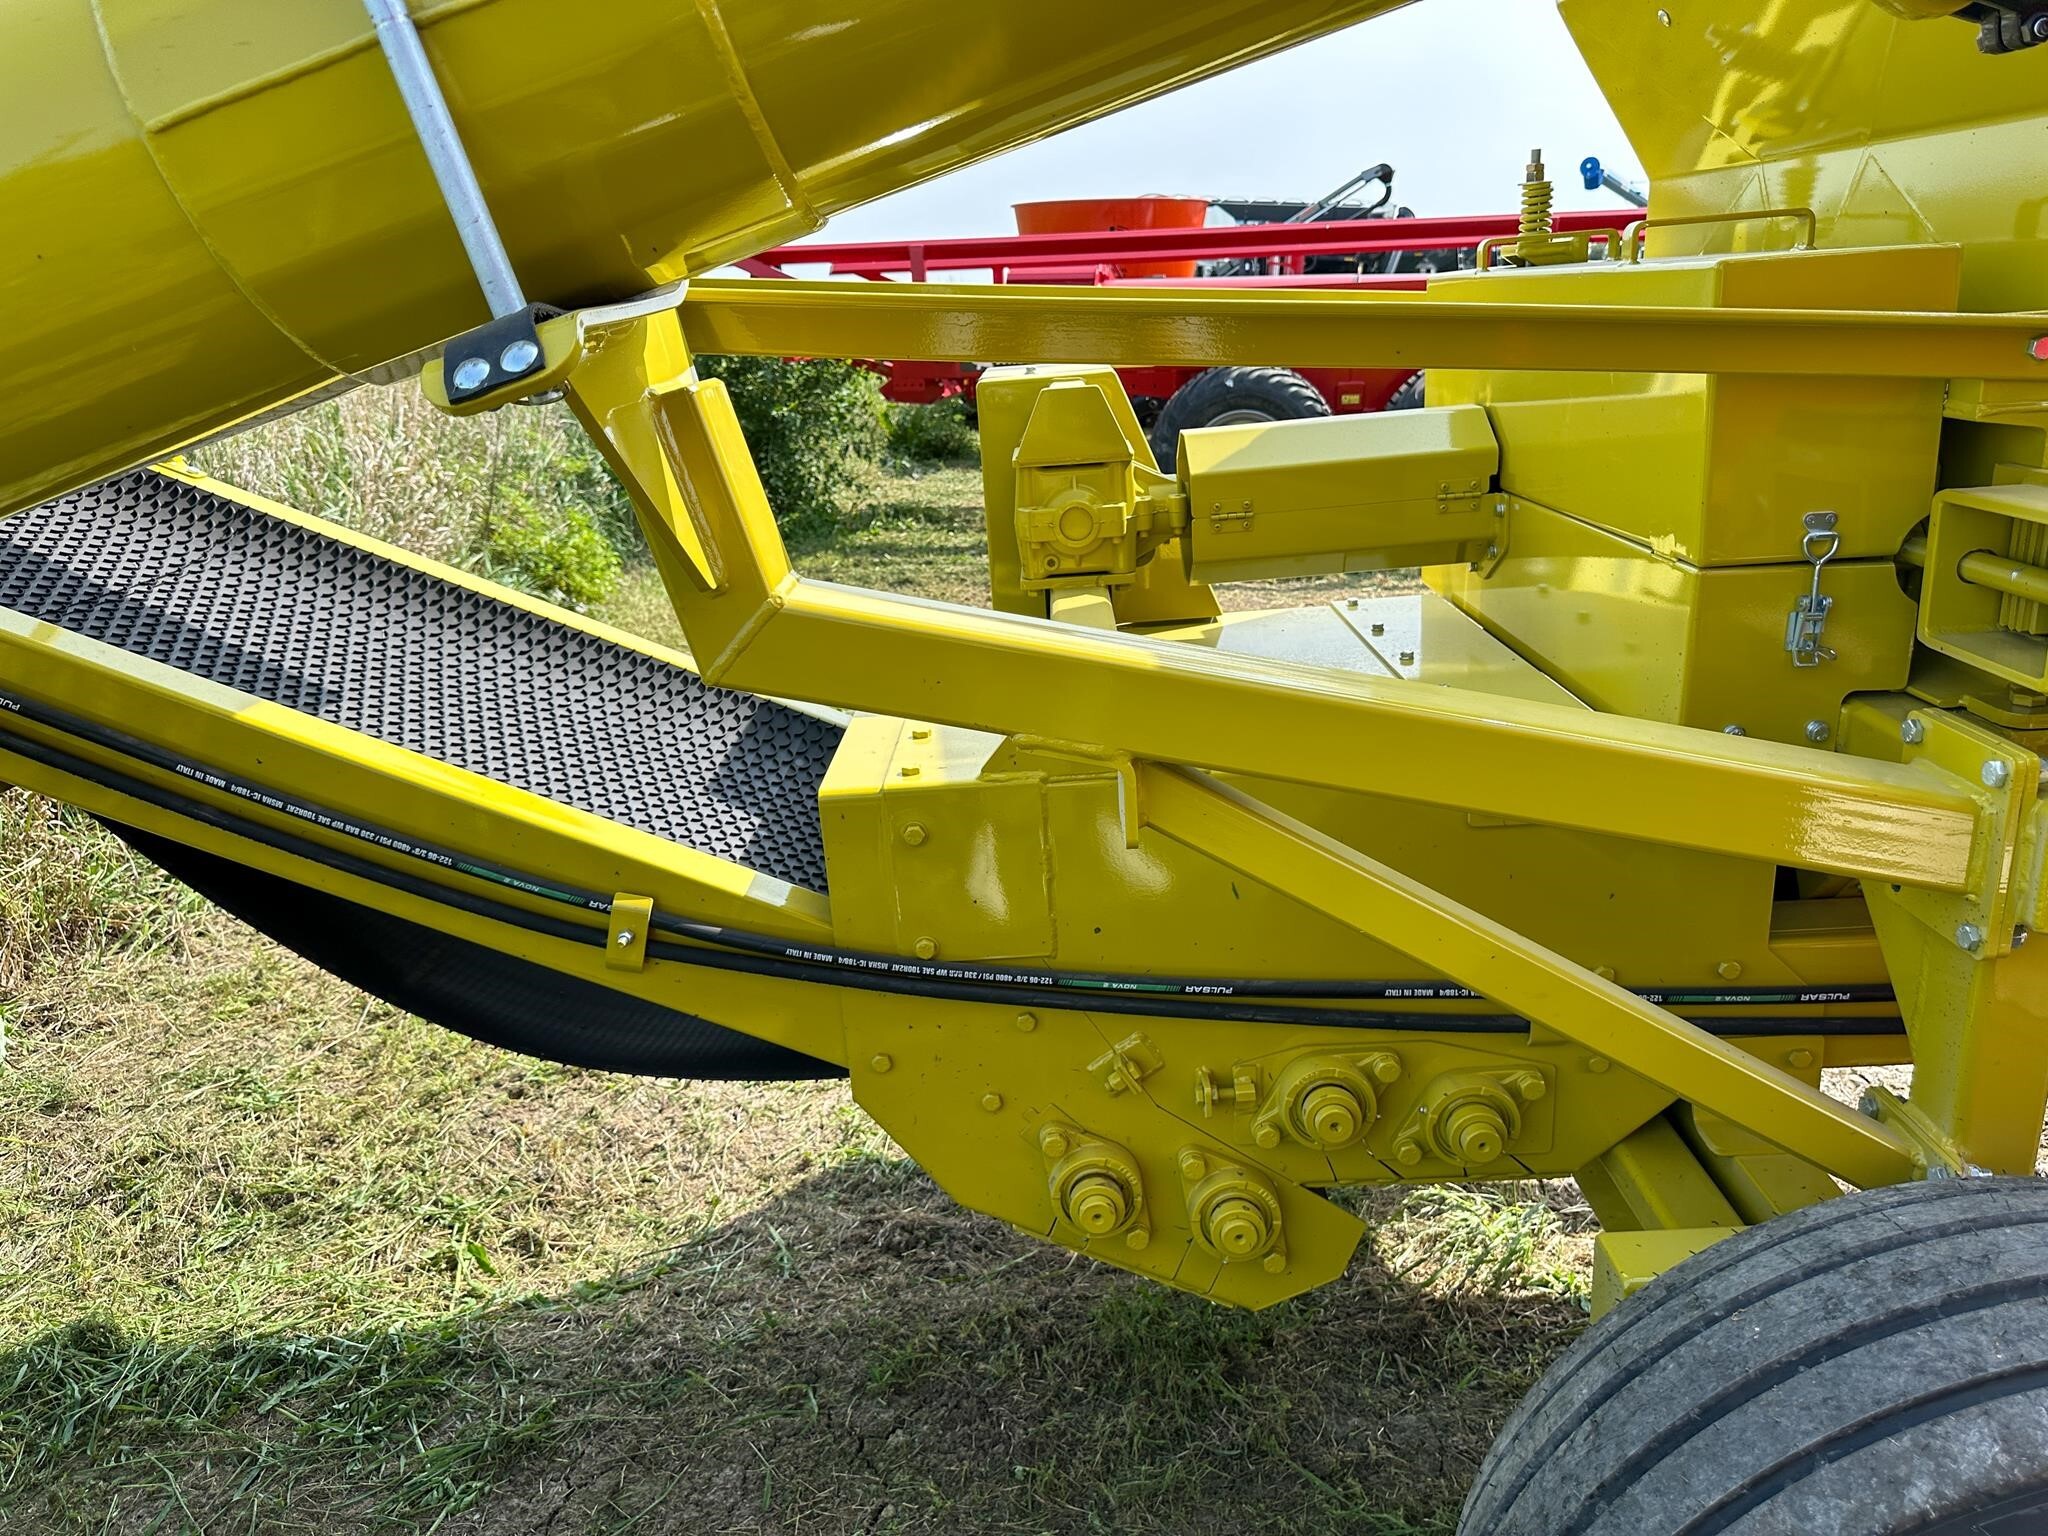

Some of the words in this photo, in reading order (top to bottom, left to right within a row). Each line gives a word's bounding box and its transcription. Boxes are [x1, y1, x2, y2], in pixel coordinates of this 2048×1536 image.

[175, 764, 195, 776] ITALY
[195, 770, 204, 780] IN
[205, 774, 226, 788] MADE
[230, 783, 261, 801] IC-188/4
[262, 795, 283, 809] MSHA
[286, 804, 316, 820] 100R2AT
[318, 814, 331, 826] SAE
[331, 820, 344, 830] WP
[344, 824, 360, 835] BAR
[360, 830, 375, 840] 330
[380, 836, 392, 846] PSI
[392, 841, 411, 852] 4800
[427, 851, 453, 866] 122-06
[513, 880, 540, 892] NOVA
[785, 948, 802, 958] ITALY
[803, 951, 812, 960] IN
[812, 953, 833, 963] MADE
[838, 956, 867, 967] IC-188/4
[868, 960, 889, 971] MSHA
[891, 964, 921, 974] 100R2AT
[921, 966, 935, 975] SAE
[936, 968, 949, 977] WP
[964, 971, 978, 980] 330
[982, 972, 994, 981] PSI
[995, 973, 1013, 982] 4800
[1029, 976, 1053, 985] 122-06
[1184, 985, 1233, 994] PULSAR
[1384, 989, 1401, 997] ITALY
[1403, 989, 1412, 997] IN
[1413, 989, 1434, 997] MADE
[1439, 989, 1469, 997] IC-188/4
[1800, 993, 1850, 1001] PULSAR
